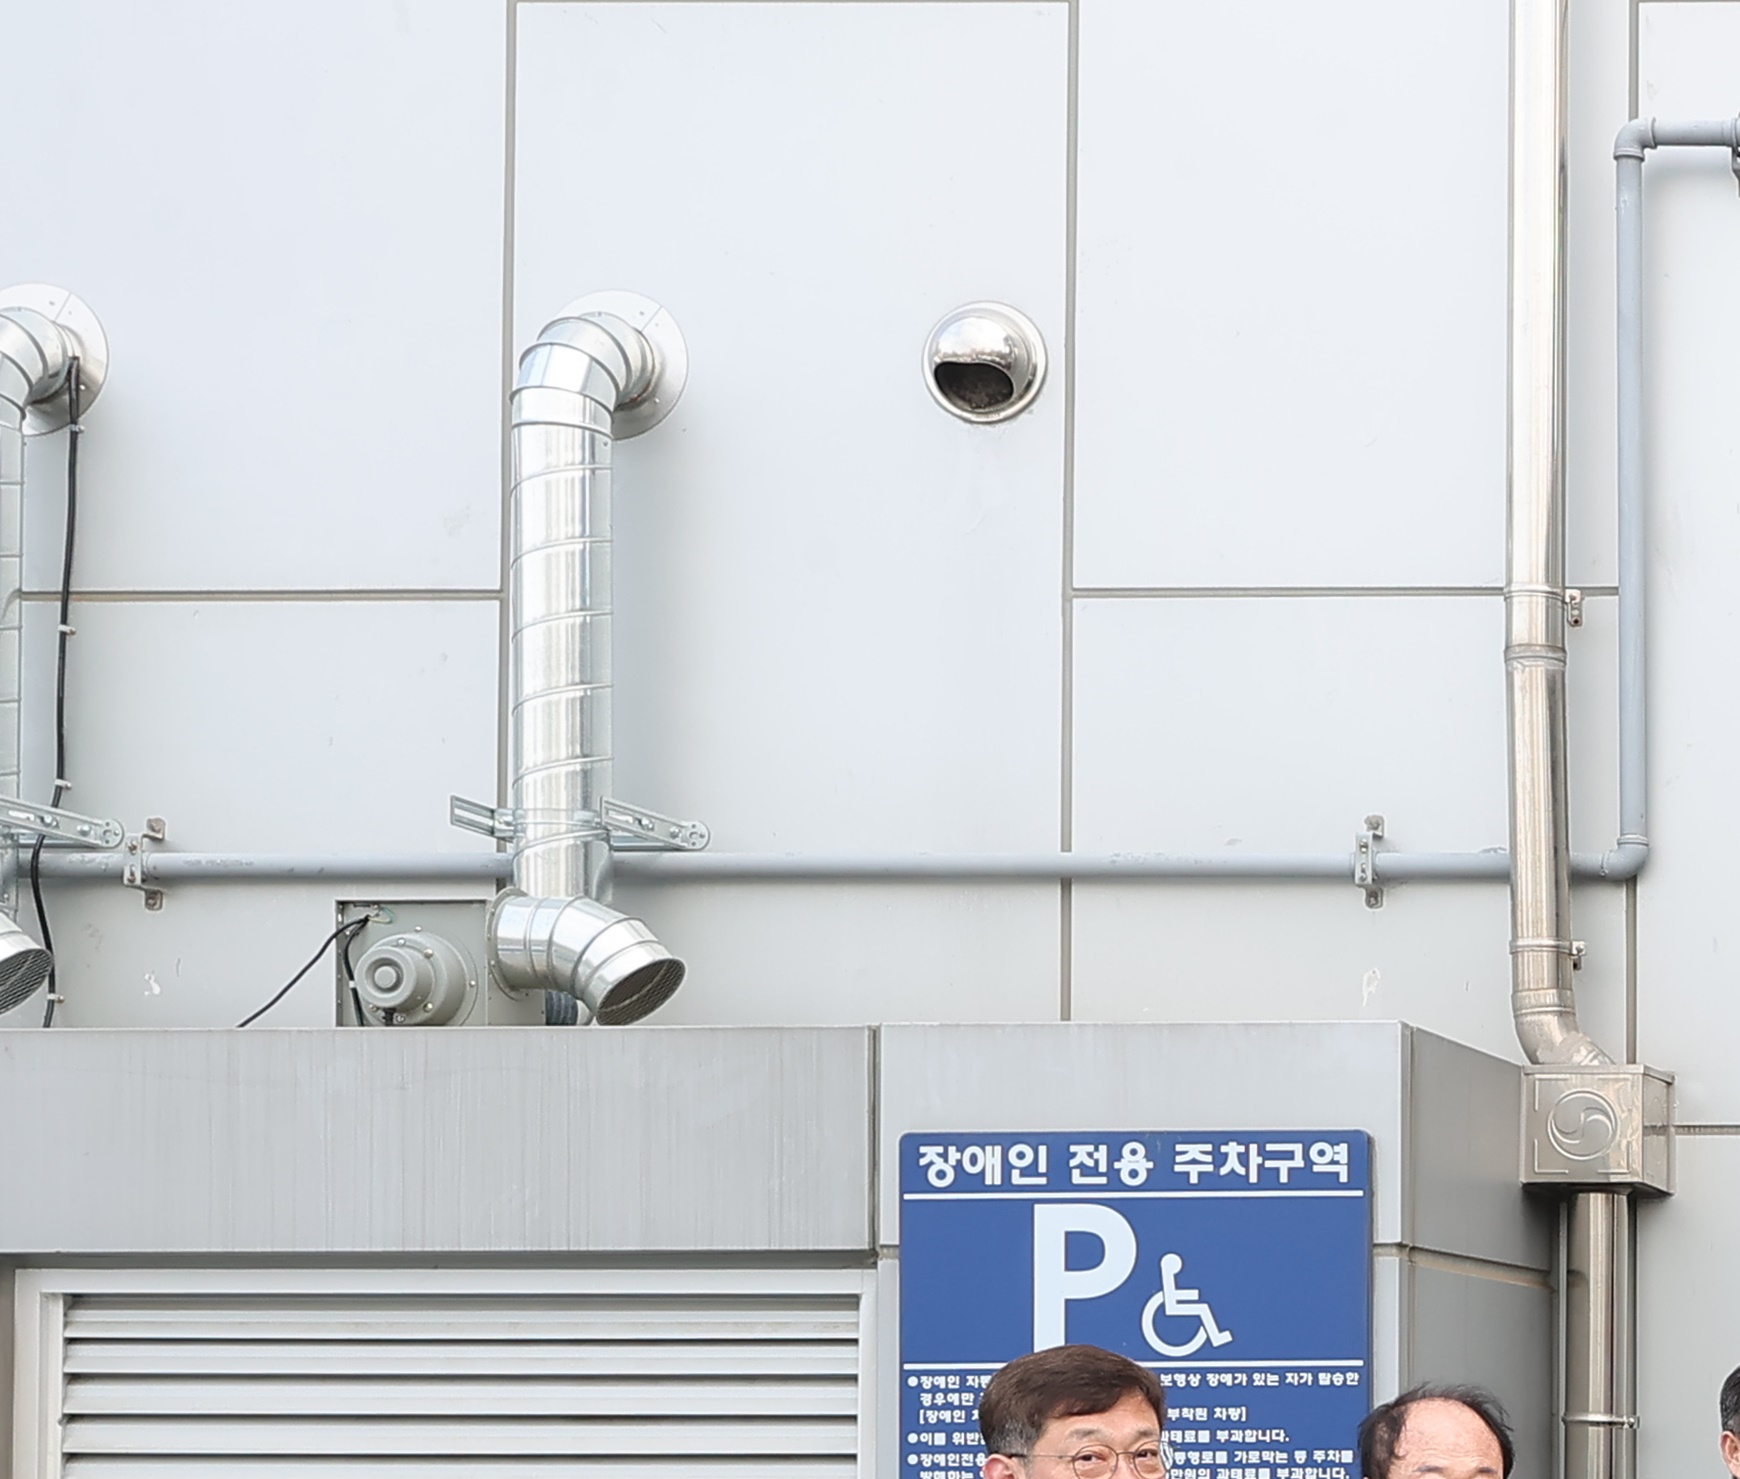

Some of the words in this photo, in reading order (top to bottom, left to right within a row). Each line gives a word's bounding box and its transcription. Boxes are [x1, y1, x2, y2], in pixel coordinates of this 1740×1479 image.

[918, 1143, 1048, 1188] 장애인
[1068, 1141, 1155, 1187] 전용
[1173, 1140, 1349, 1185] 주차구역
[1033, 1203, 1137, 1353] P
[920, 1376, 960, 1389] 장애인
[1160, 1373, 1201, 1386] 보행상
[1206, 1373, 1247, 1386] 장애가
[1253, 1373, 1279, 1386] 있는
[1285, 1372, 1312, 1386] 자가
[920, 1393, 974, 1406] 경우에만
[1167, 1408, 1208, 1421] 부착된
[920, 1432, 946, 1446] 이를
[952, 1432, 986, 1446] 위반
[1216, 1429, 1290, 1443] 부과합니다.
[1234, 1450, 1288, 1464] 가로막는
[1312, 1450, 1354, 1463] 주차를
